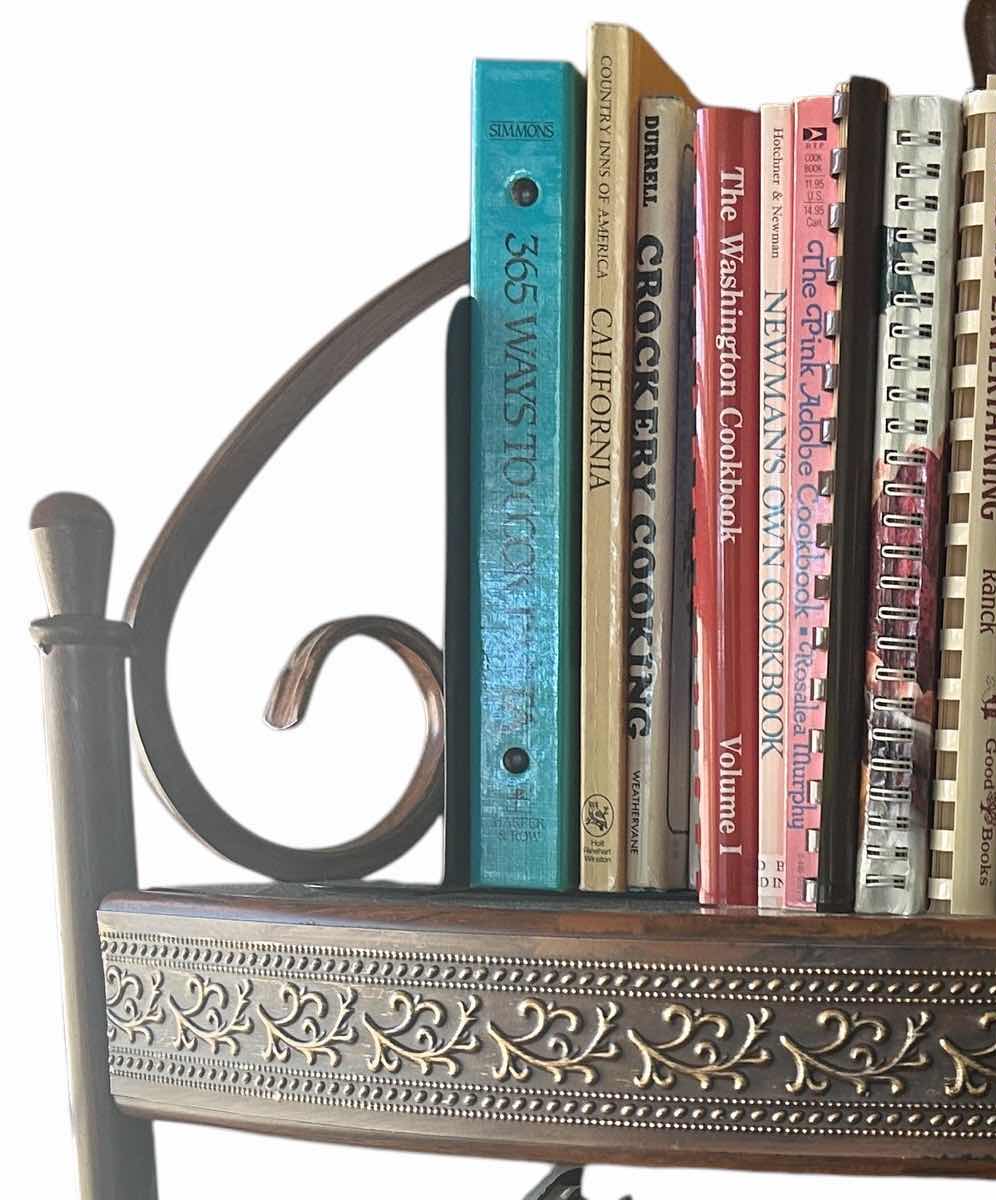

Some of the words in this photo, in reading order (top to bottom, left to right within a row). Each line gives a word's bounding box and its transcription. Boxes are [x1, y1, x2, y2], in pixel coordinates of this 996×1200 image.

[489, 125, 554, 137] SIMMONS
[599, 56, 612, 134] COUNTRY
[599, 141, 611, 177] INNS
[599, 183, 610, 204] OF
[643, 116, 659, 207] DURRELL
[720, 167, 744, 220] The
[597, 210, 610, 278] AMERICA
[717, 233, 743, 401] Washington
[589, 308, 613, 490] CALIFORNIA
[629, 235, 663, 499] CROCKERY
[764, 289, 787, 473] NEWMAN'S
[718, 408, 743, 544] Cookbook
[762, 486, 784, 567] OWN
[627, 514, 657, 739] COOKING
[761, 581, 784, 759] COOKBOOK
[630, 771, 641, 855] WEATHERVANE
